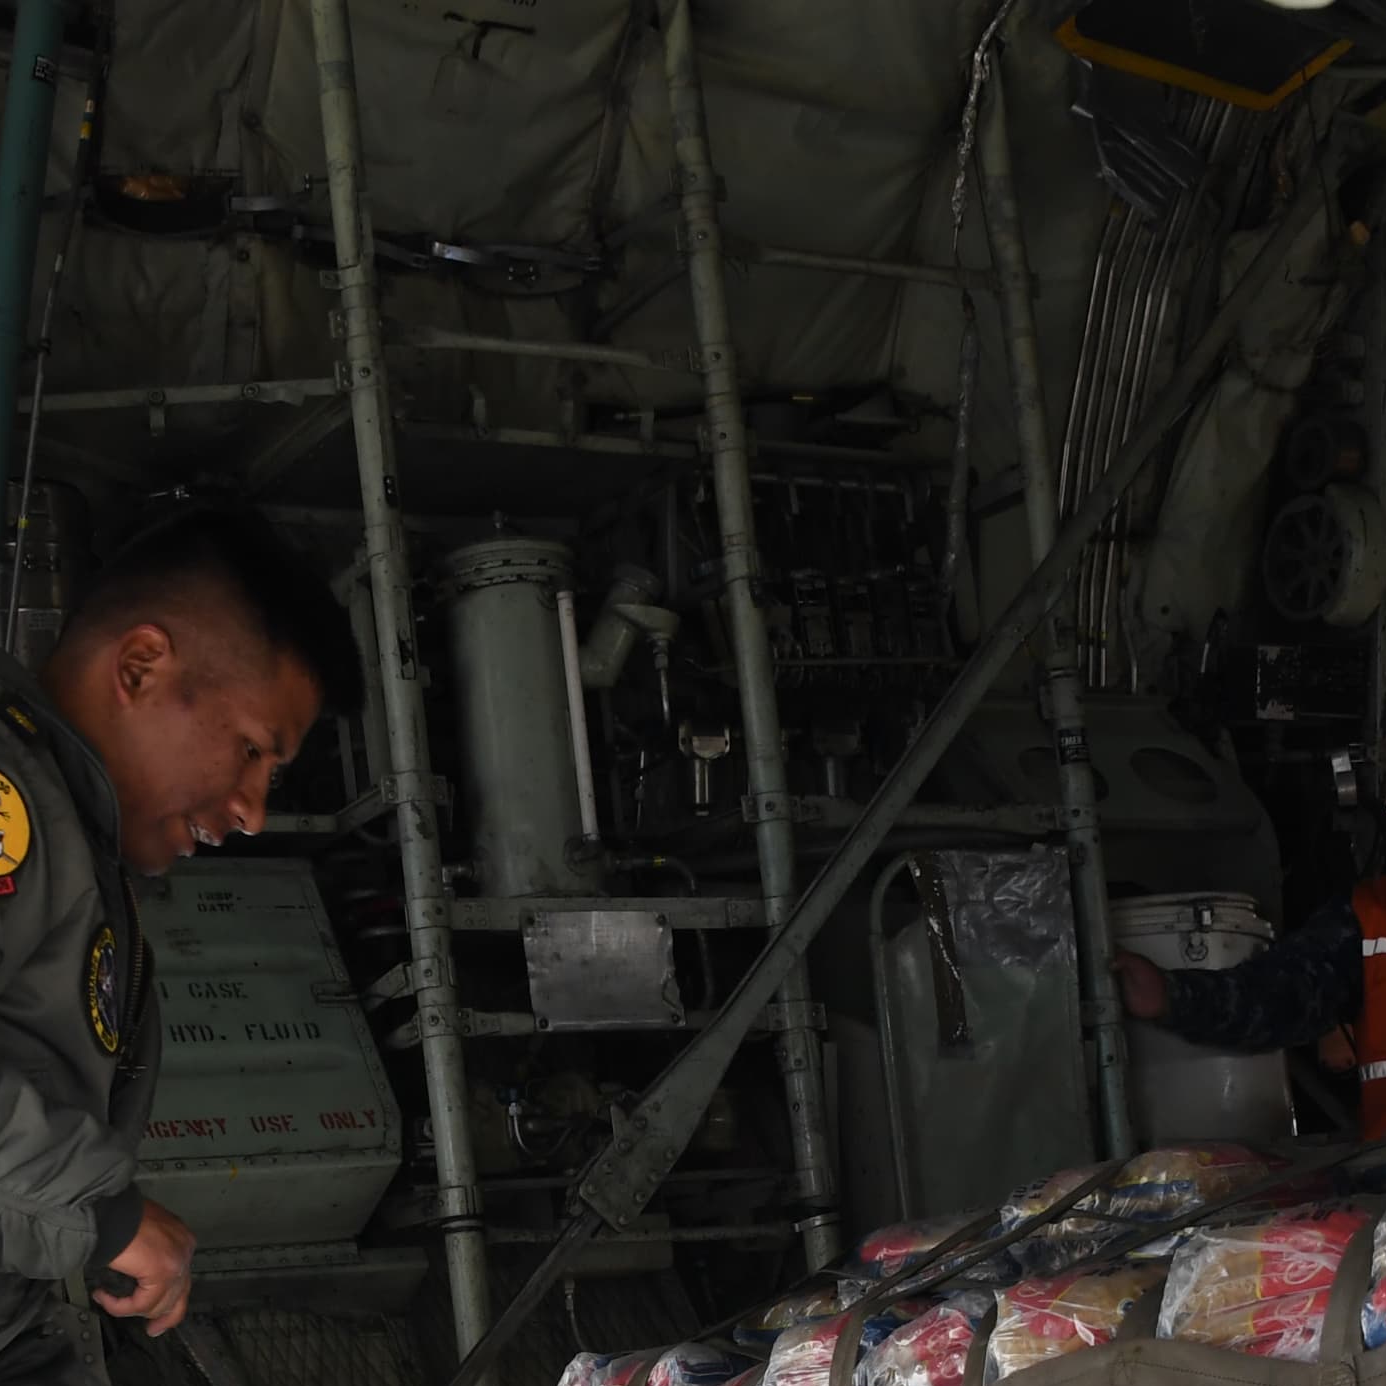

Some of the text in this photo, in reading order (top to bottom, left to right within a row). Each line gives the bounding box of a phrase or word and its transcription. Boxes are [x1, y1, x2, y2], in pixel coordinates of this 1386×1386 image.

[197, 902, 236, 914] DATE
[187, 981, 250, 1001] CASE
[169, 1021, 323, 1043] HYD. FLUID
[141, 1109, 378, 1140] RGENCY USE ONLY
